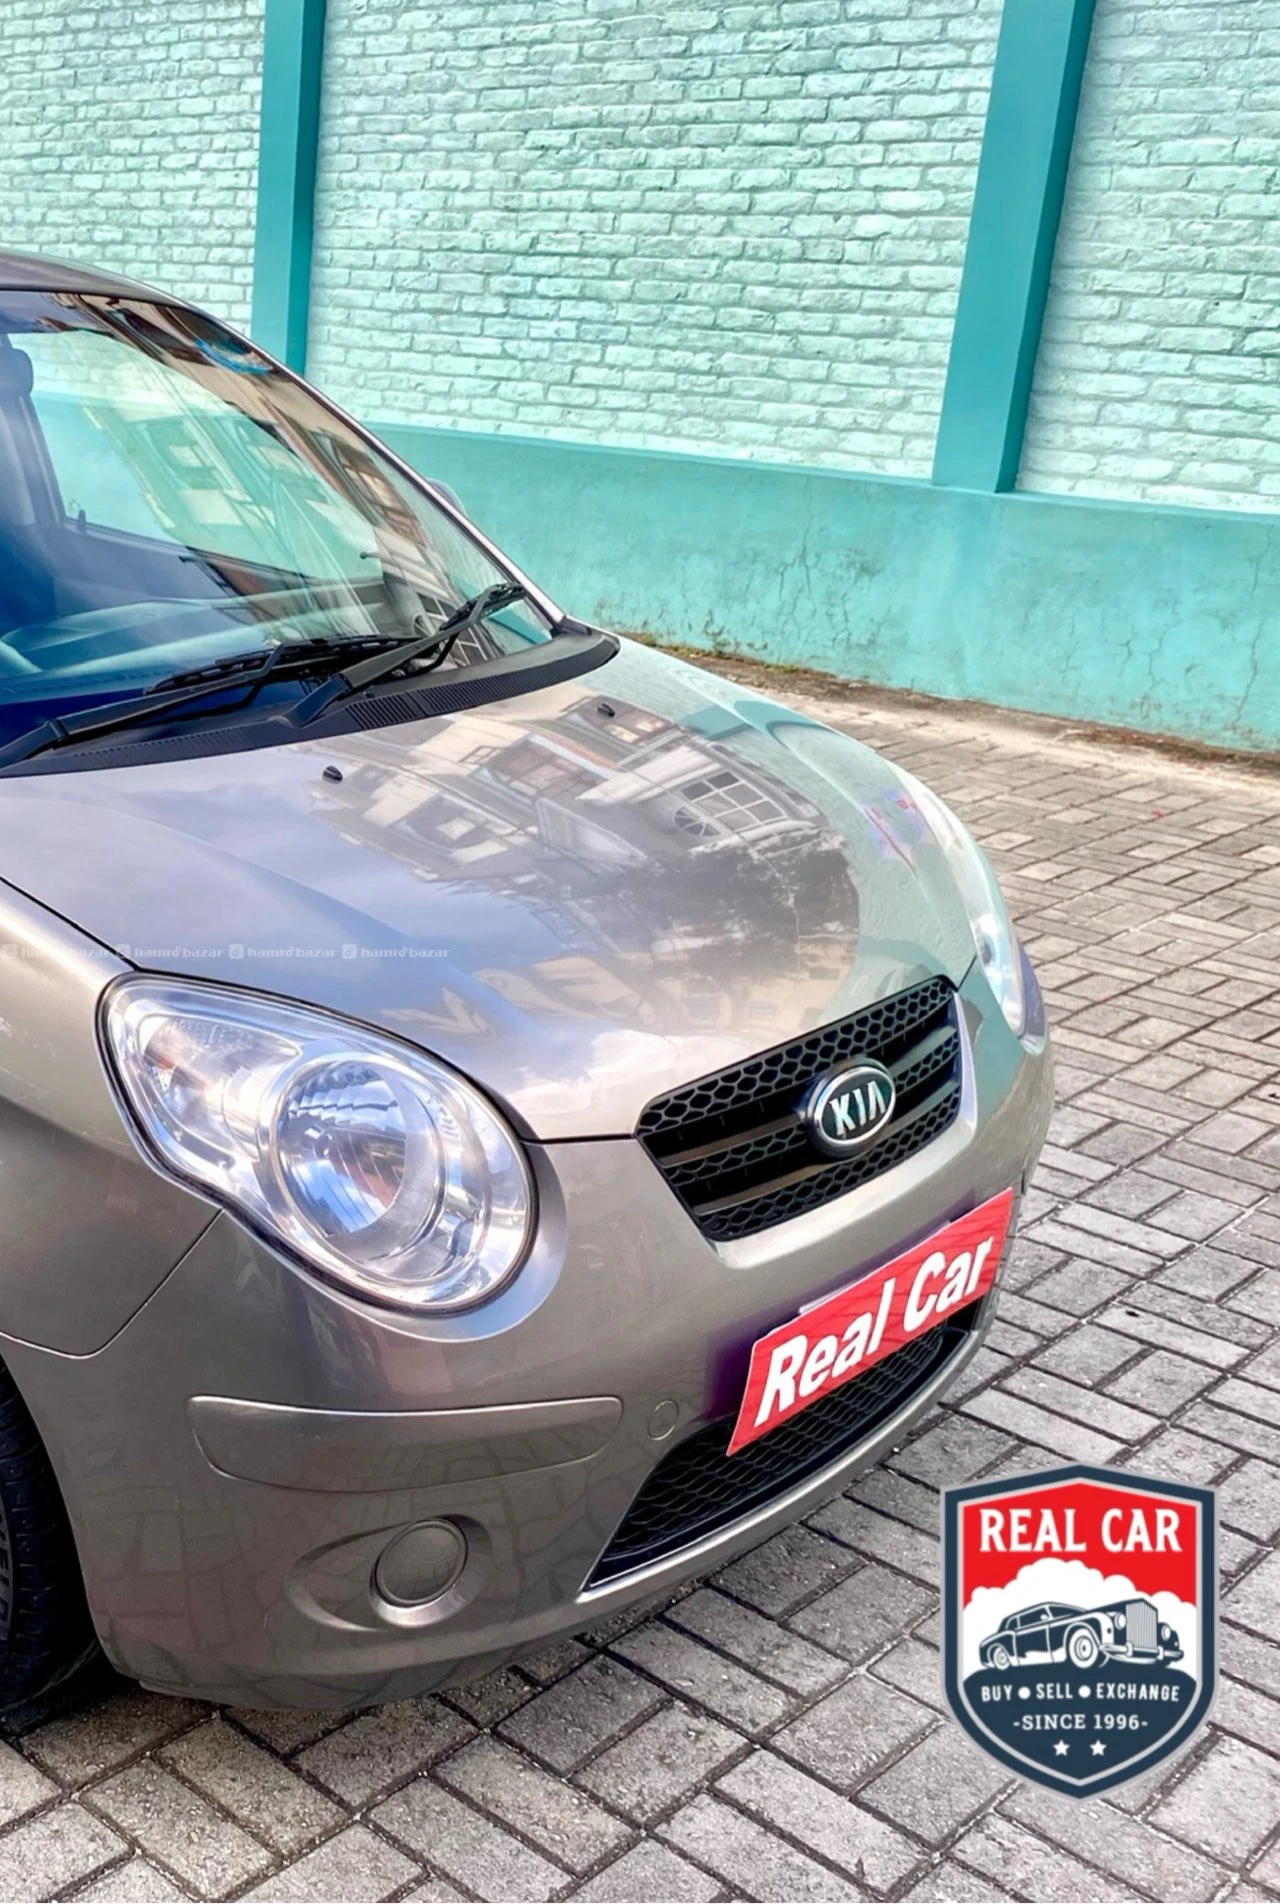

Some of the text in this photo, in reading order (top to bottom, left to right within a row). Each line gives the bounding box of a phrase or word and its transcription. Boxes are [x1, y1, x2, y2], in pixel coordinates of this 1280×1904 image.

[828, 1080, 887, 1137] KIA
[753, 1236, 994, 1428] Real Car
